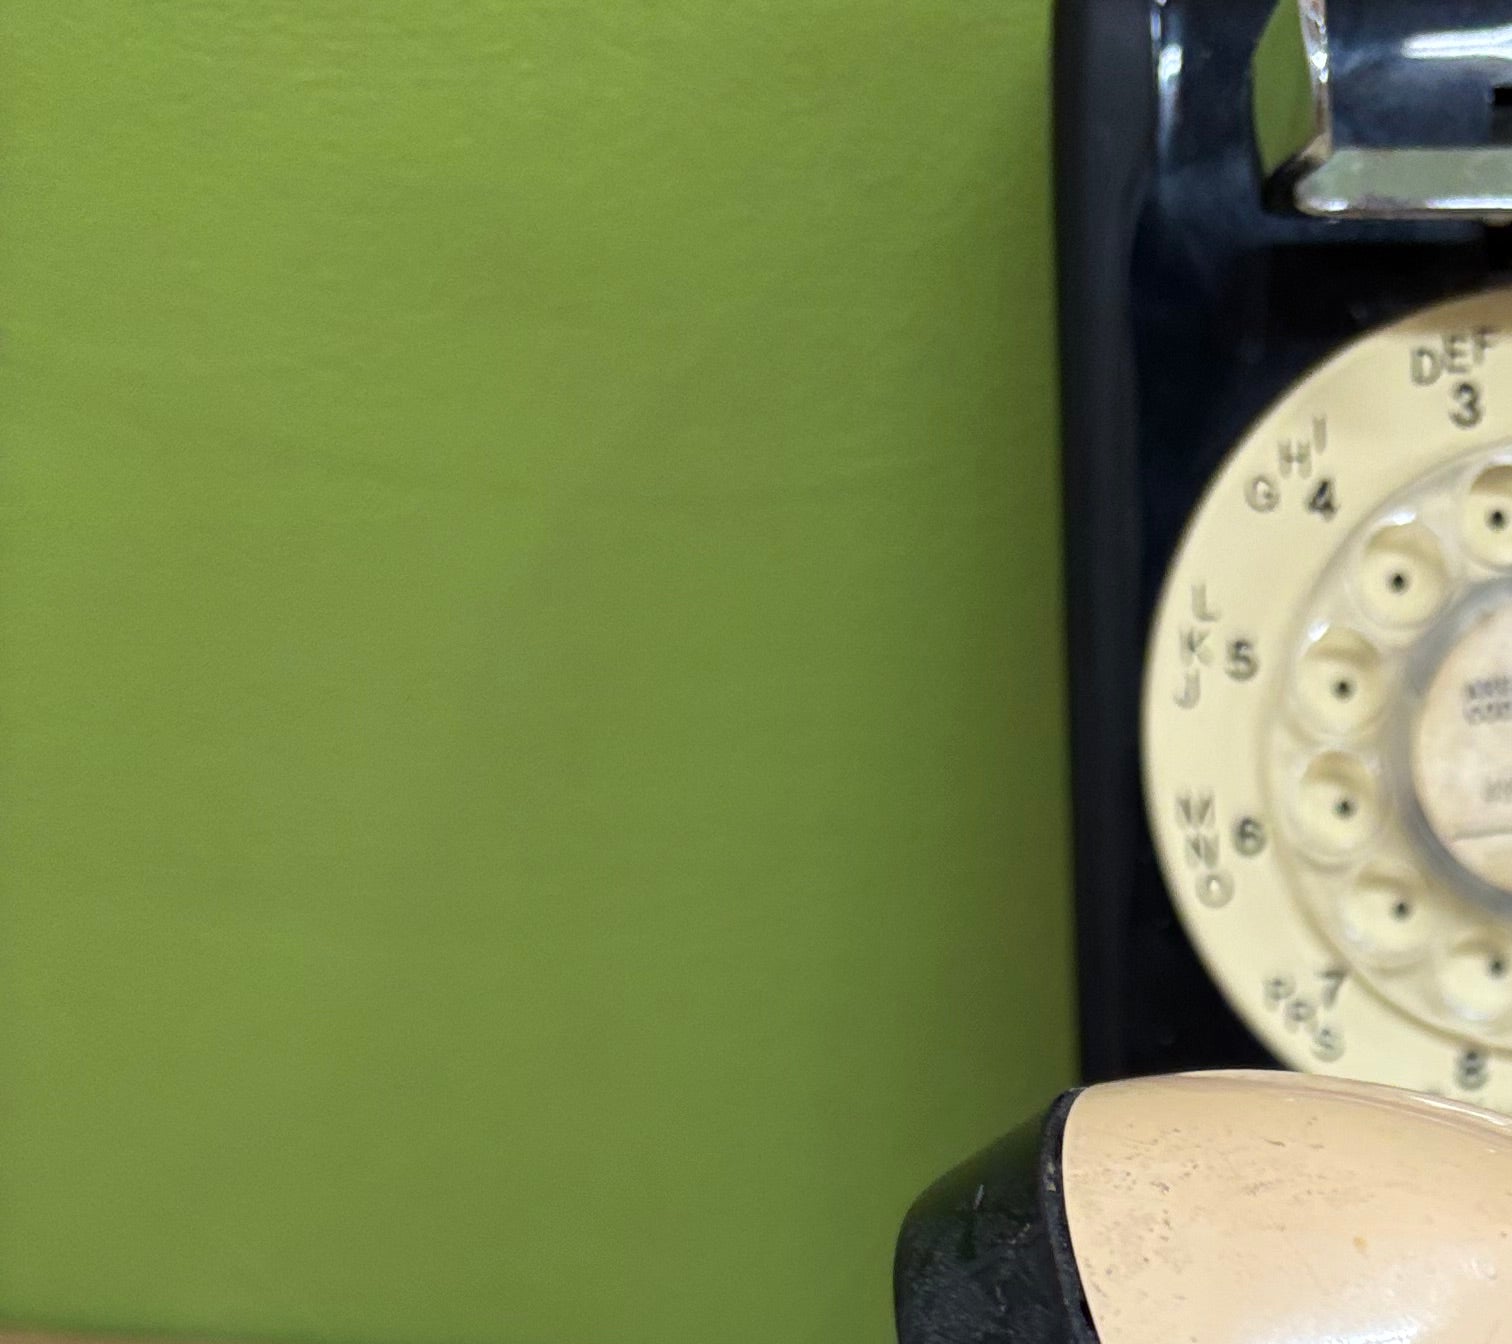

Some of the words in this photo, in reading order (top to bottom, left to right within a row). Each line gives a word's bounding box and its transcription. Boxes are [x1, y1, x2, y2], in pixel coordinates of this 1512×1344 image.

[1410, 325, 1499, 386] DEF
[1449, 381, 1484, 429] 3
[1306, 476, 1338, 523] 4
[1223, 634, 1260, 683] 5
[1231, 814, 1267, 858] 6
[1315, 965, 1350, 1012] 7
[1454, 1047, 1490, 1091] 8
